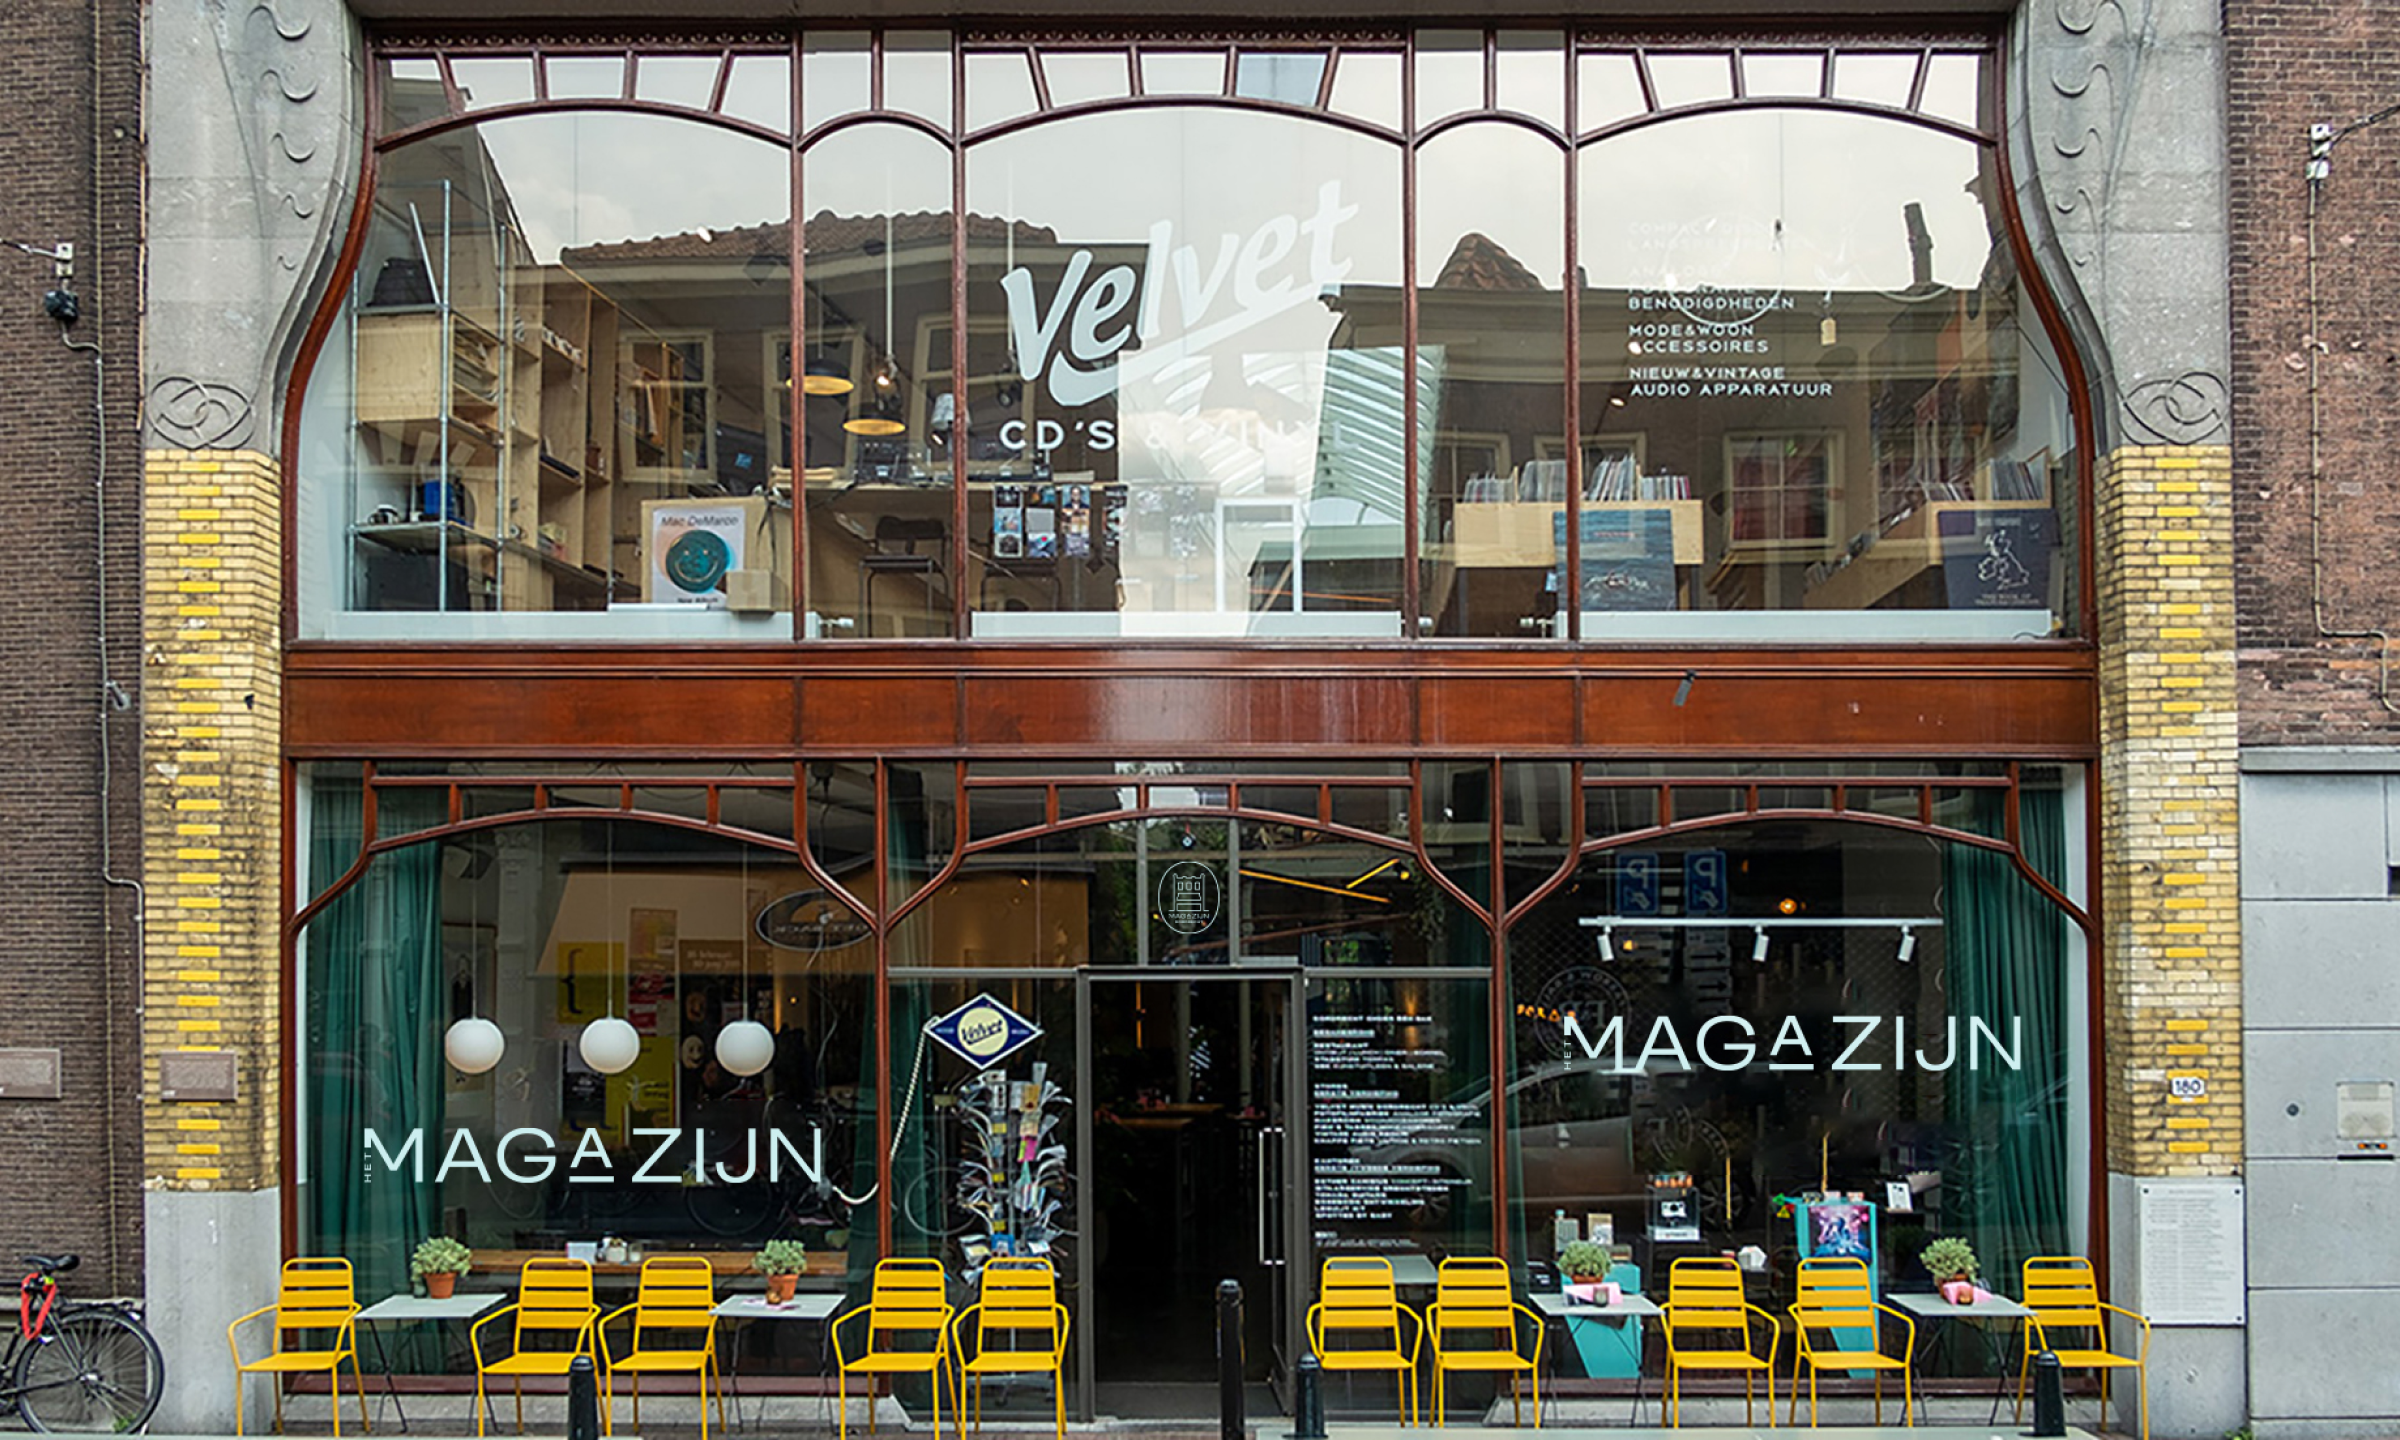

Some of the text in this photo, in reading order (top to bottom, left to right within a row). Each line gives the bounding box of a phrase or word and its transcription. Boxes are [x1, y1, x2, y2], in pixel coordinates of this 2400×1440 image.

[1000, 179, 1359, 407] Velvet
[1628, 297, 1795, 310] BENODIGDHEDEN
[1629, 341, 1769, 353] CCESSOIRES
[1631, 384, 1833, 396] AUDIO APPARATUUR
[999, 420, 1117, 451] CD'S
[660, 514, 739, 526] Mac DeMarco
[1563, 1015, 2022, 1071] HET MAGAZIJN
[2174, 1079, 2202, 1094] 180
[364, 1127, 822, 1184] HET MAGAZIJN
